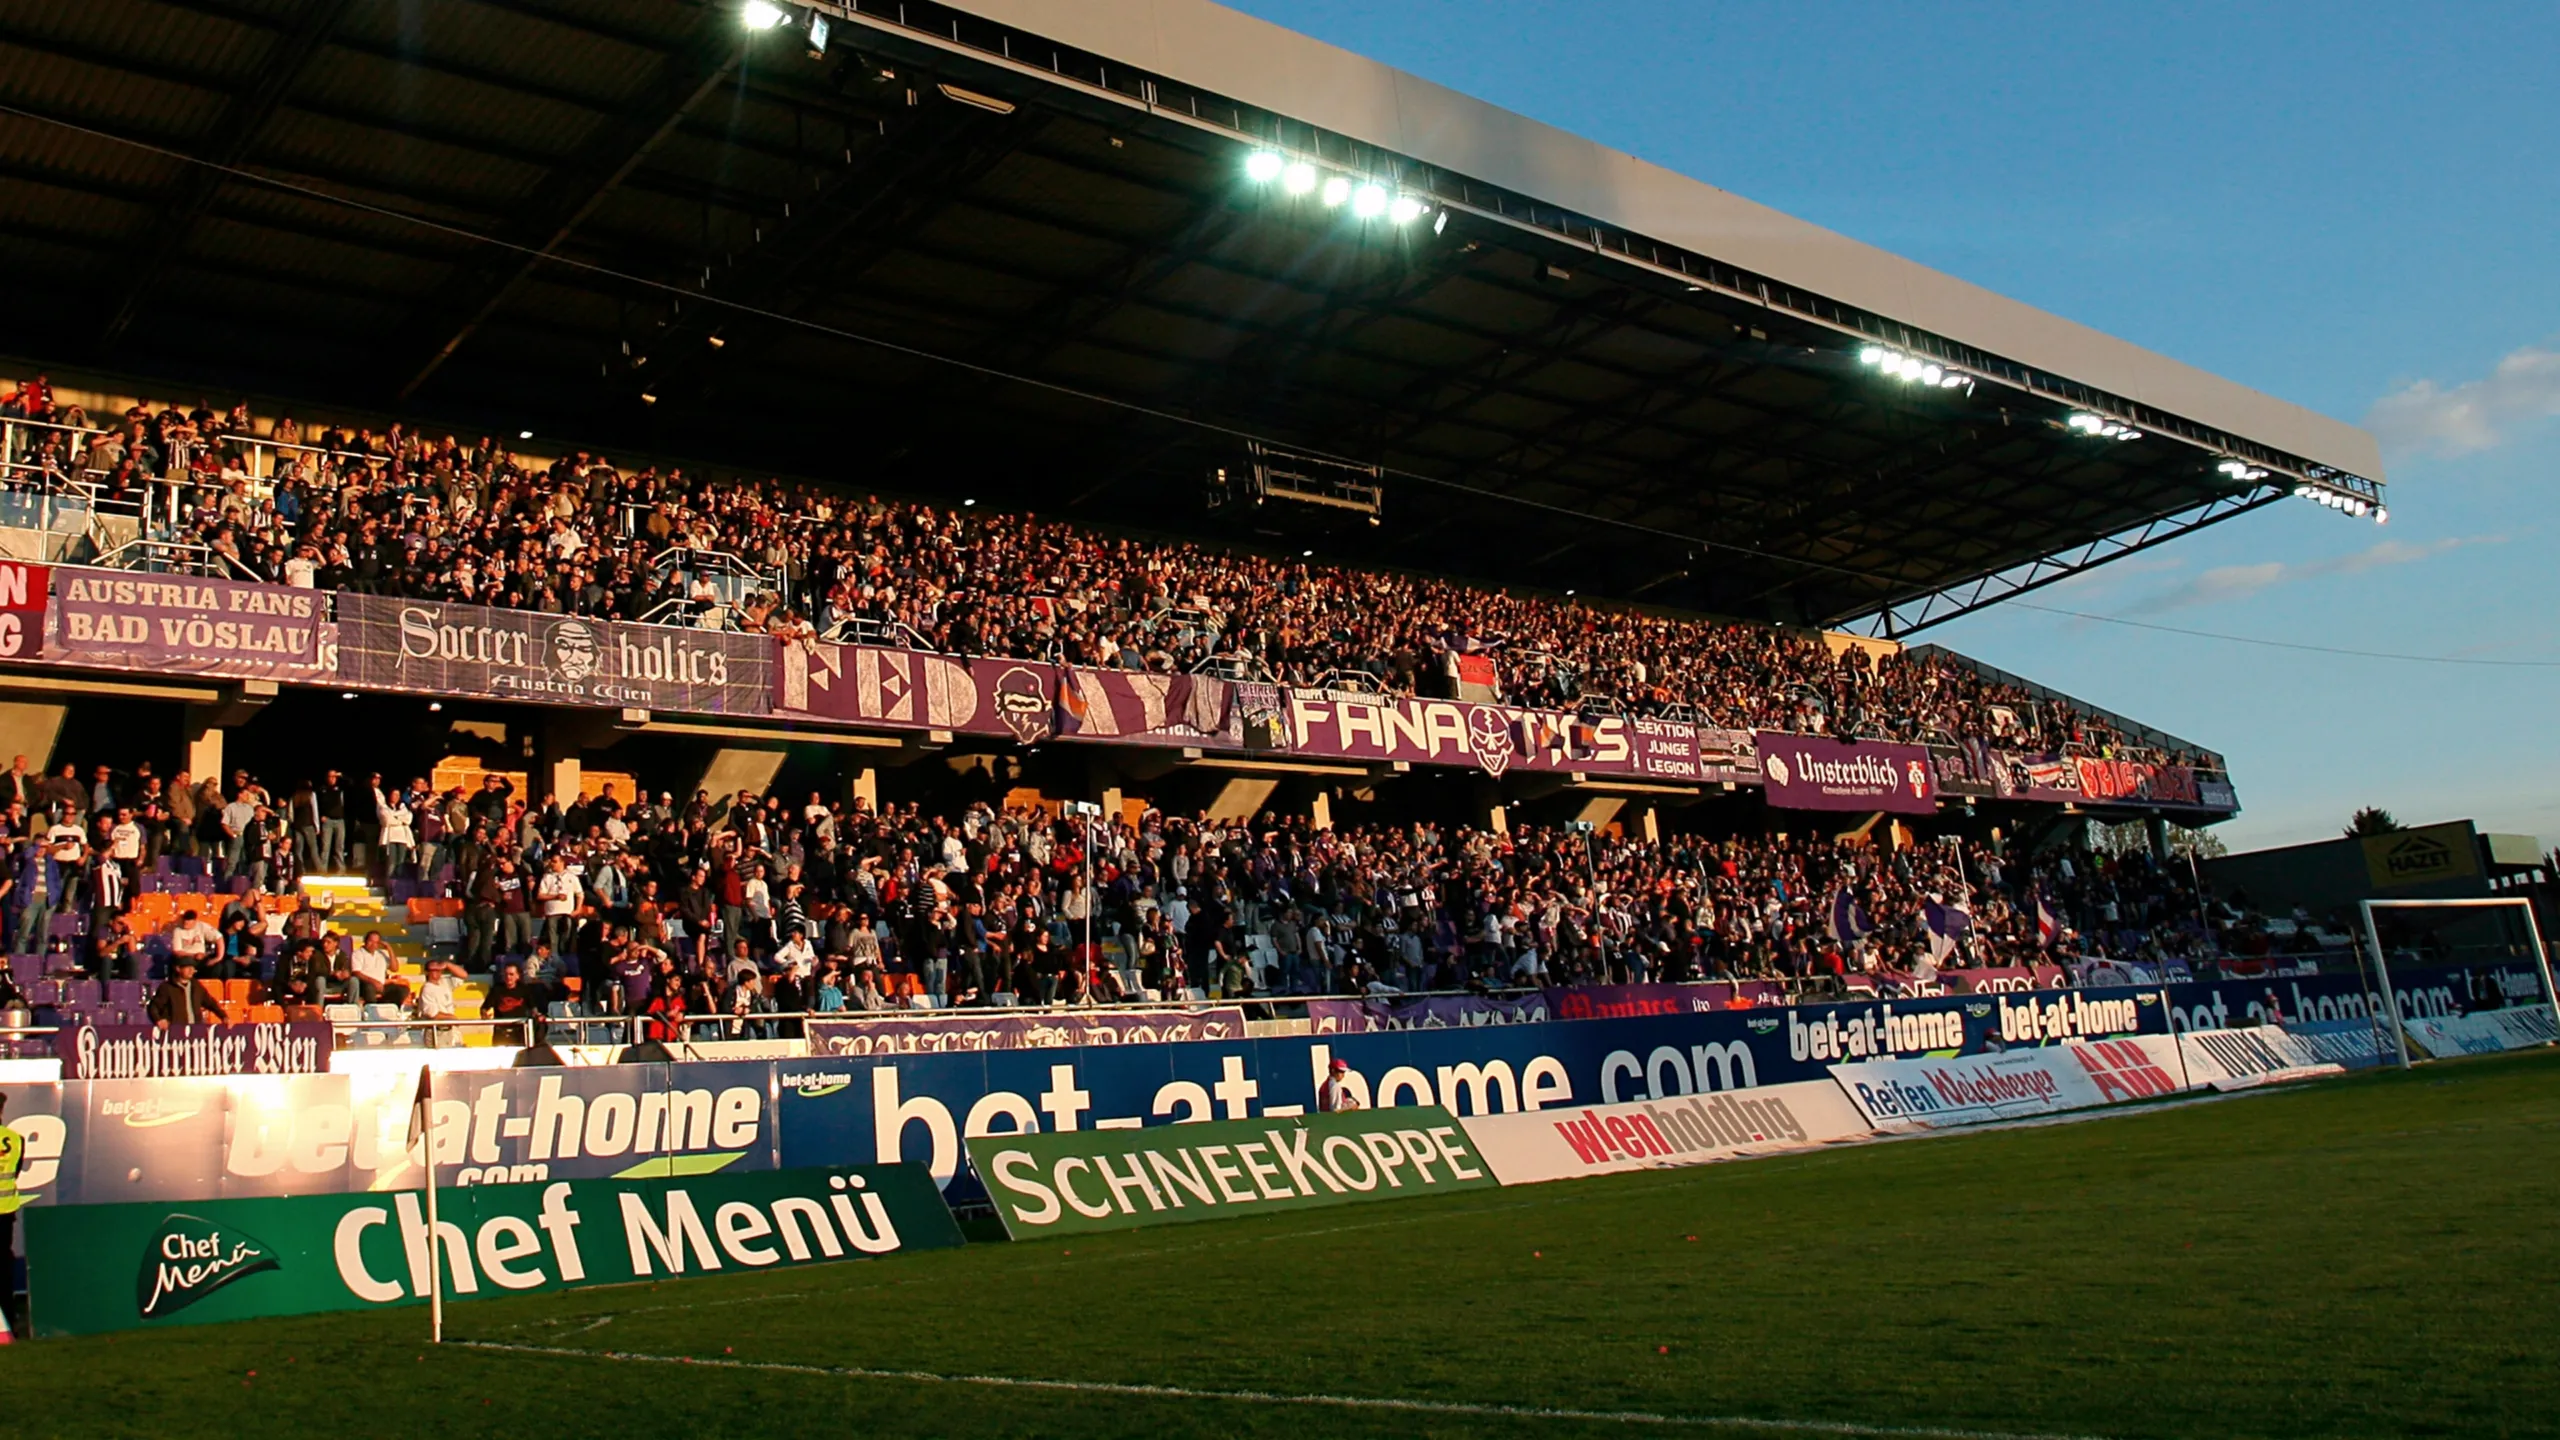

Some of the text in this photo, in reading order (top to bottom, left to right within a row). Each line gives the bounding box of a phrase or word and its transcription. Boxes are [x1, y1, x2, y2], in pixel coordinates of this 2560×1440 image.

[68, 578, 313, 618] AUSTRIA FANS
[67, 612, 311, 656] BAD VÖSLAU
[395, 606, 528, 669] Soccer
[619, 631, 729, 686] holics
[490, 673, 652, 702] Austria Wien
[1636, 721, 1695, 739] SEKTION
[1647, 740, 1690, 757] JUNGE
[1647, 757, 1695, 776] LEGION
[1795, 751, 1898, 794] Unsterblich
[2388, 850, 2449, 873] HAZET
[1788, 1004, 1963, 1061] bet-at-home
[1999, 991, 2137, 1042] bet-at-home
[76, 1022, 317, 1079] Kampftrinker Wien
[2070, 1039, 2177, 1102] ABB
[782, 1071, 851, 1087] bet-at-home
[1858, 1064, 2059, 1117] Reifen Weichberger
[991, 1124, 1483, 1226] SCHNEEKOPPE
[162, 1232, 221, 1260] Chef
[333, 1174, 901, 1302] Chef Menü
[144, 1241, 260, 1313] Menü
